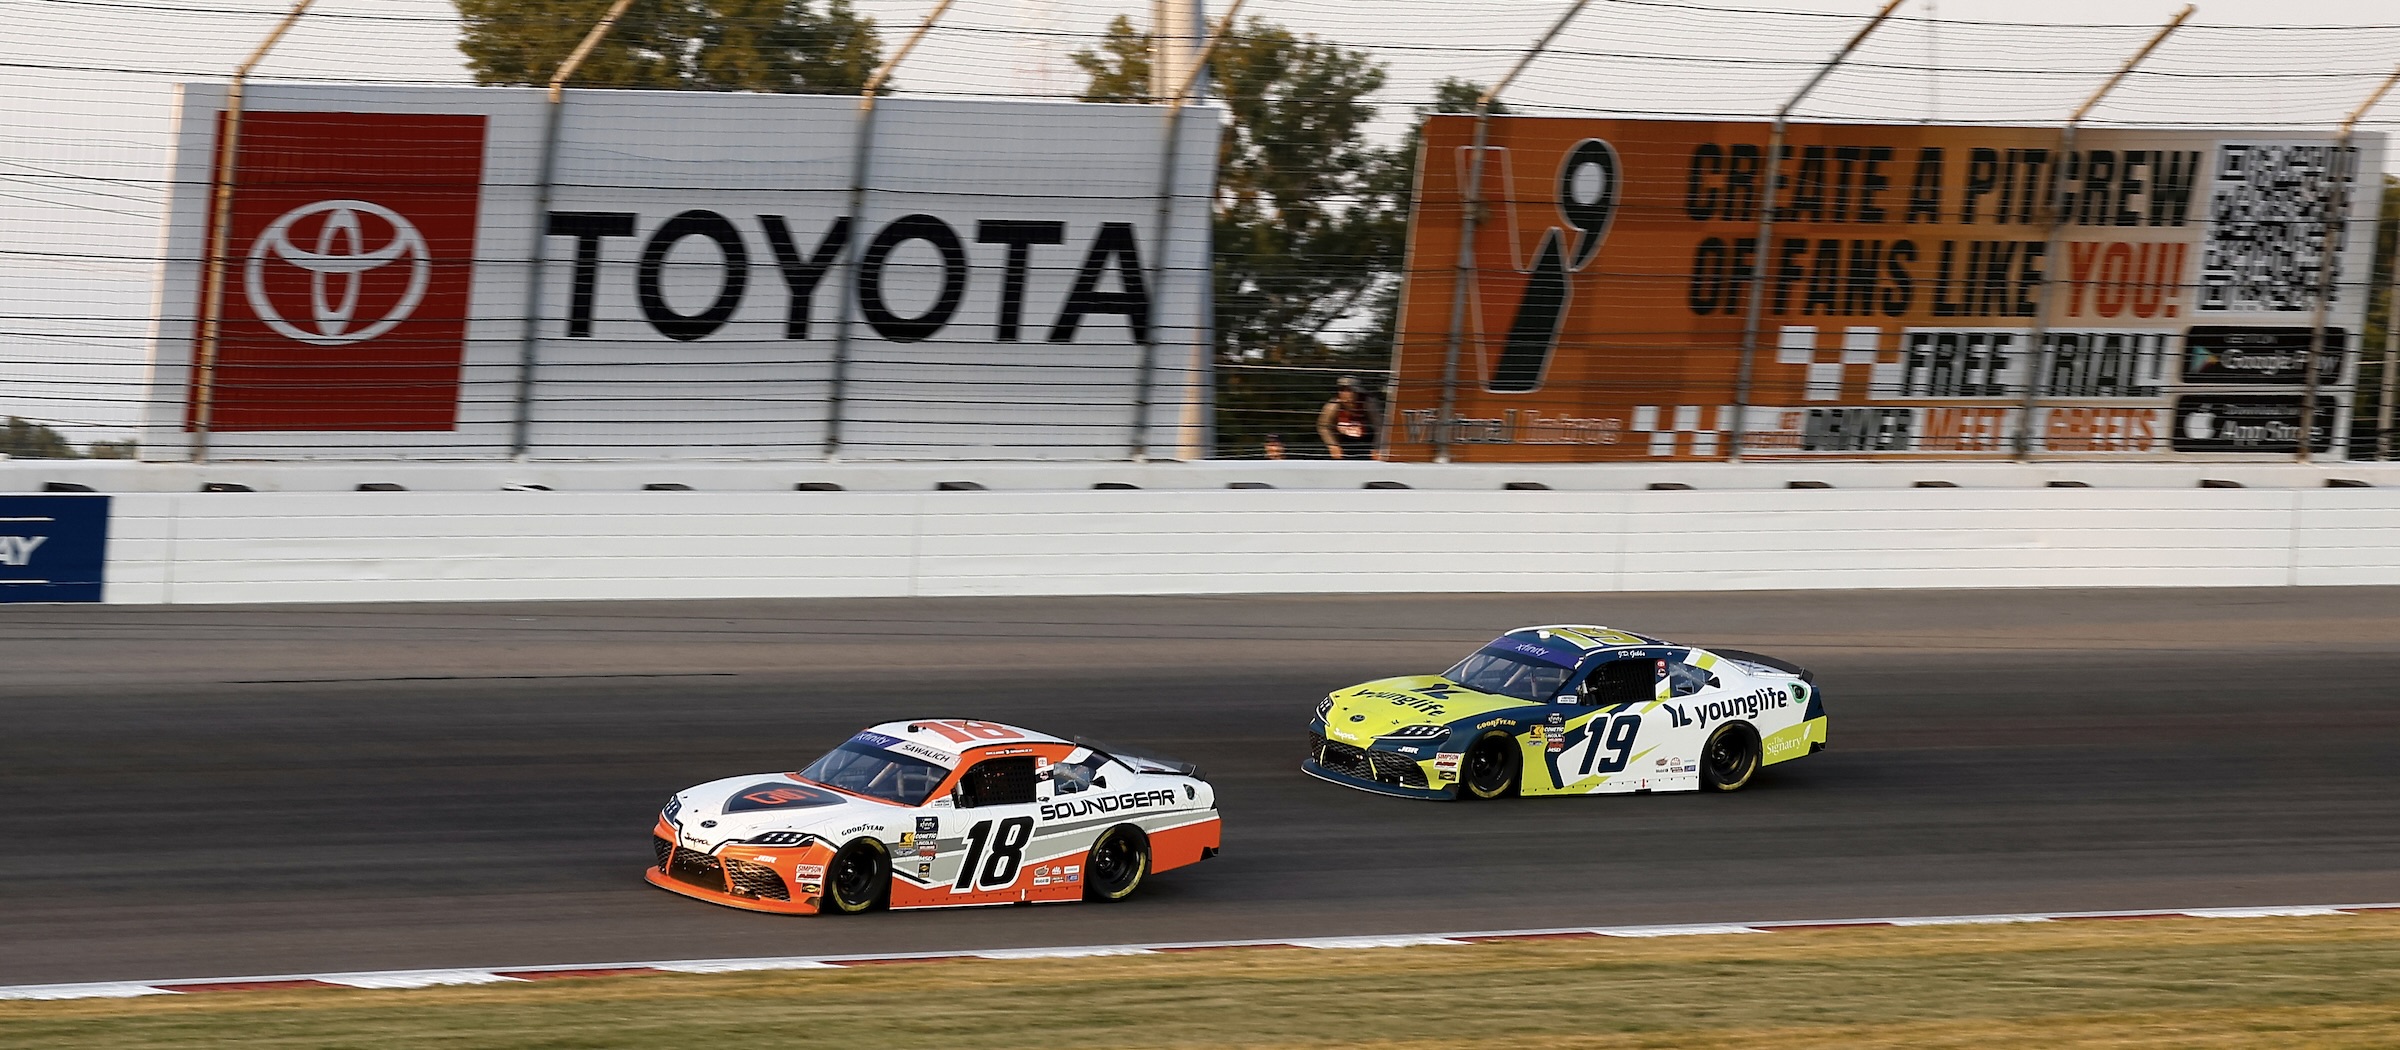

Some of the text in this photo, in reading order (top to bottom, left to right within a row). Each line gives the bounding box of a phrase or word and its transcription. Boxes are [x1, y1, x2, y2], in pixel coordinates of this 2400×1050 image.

[1687, 143, 1893, 223] CREATE
[1907, 147, 1944, 224] A
[547, 210, 1153, 343] TOYOTA
[1688, 238, 2188, 318] OF FANS LIKE YOU!
[1903, 332, 2011, 397] FREE
[1515, 643, 1549, 657] xfinity
[1351, 689, 1447, 717] younglife
[1694, 687, 1789, 730] younglife
[917, 720, 1025, 744] 18
[1476, 717, 1518, 731] GOODYEAR
[856, 733, 890, 747] xfinity
[901, 744, 952, 763] SAWALICH
[1578, 713, 1643, 776] 19
[1766, 736, 1802, 755] Signatry
[1040, 789, 1176, 821] SOUNDGEAR
[841, 823, 885, 837] GOODYEAR
[954, 814, 1035, 891] 18
